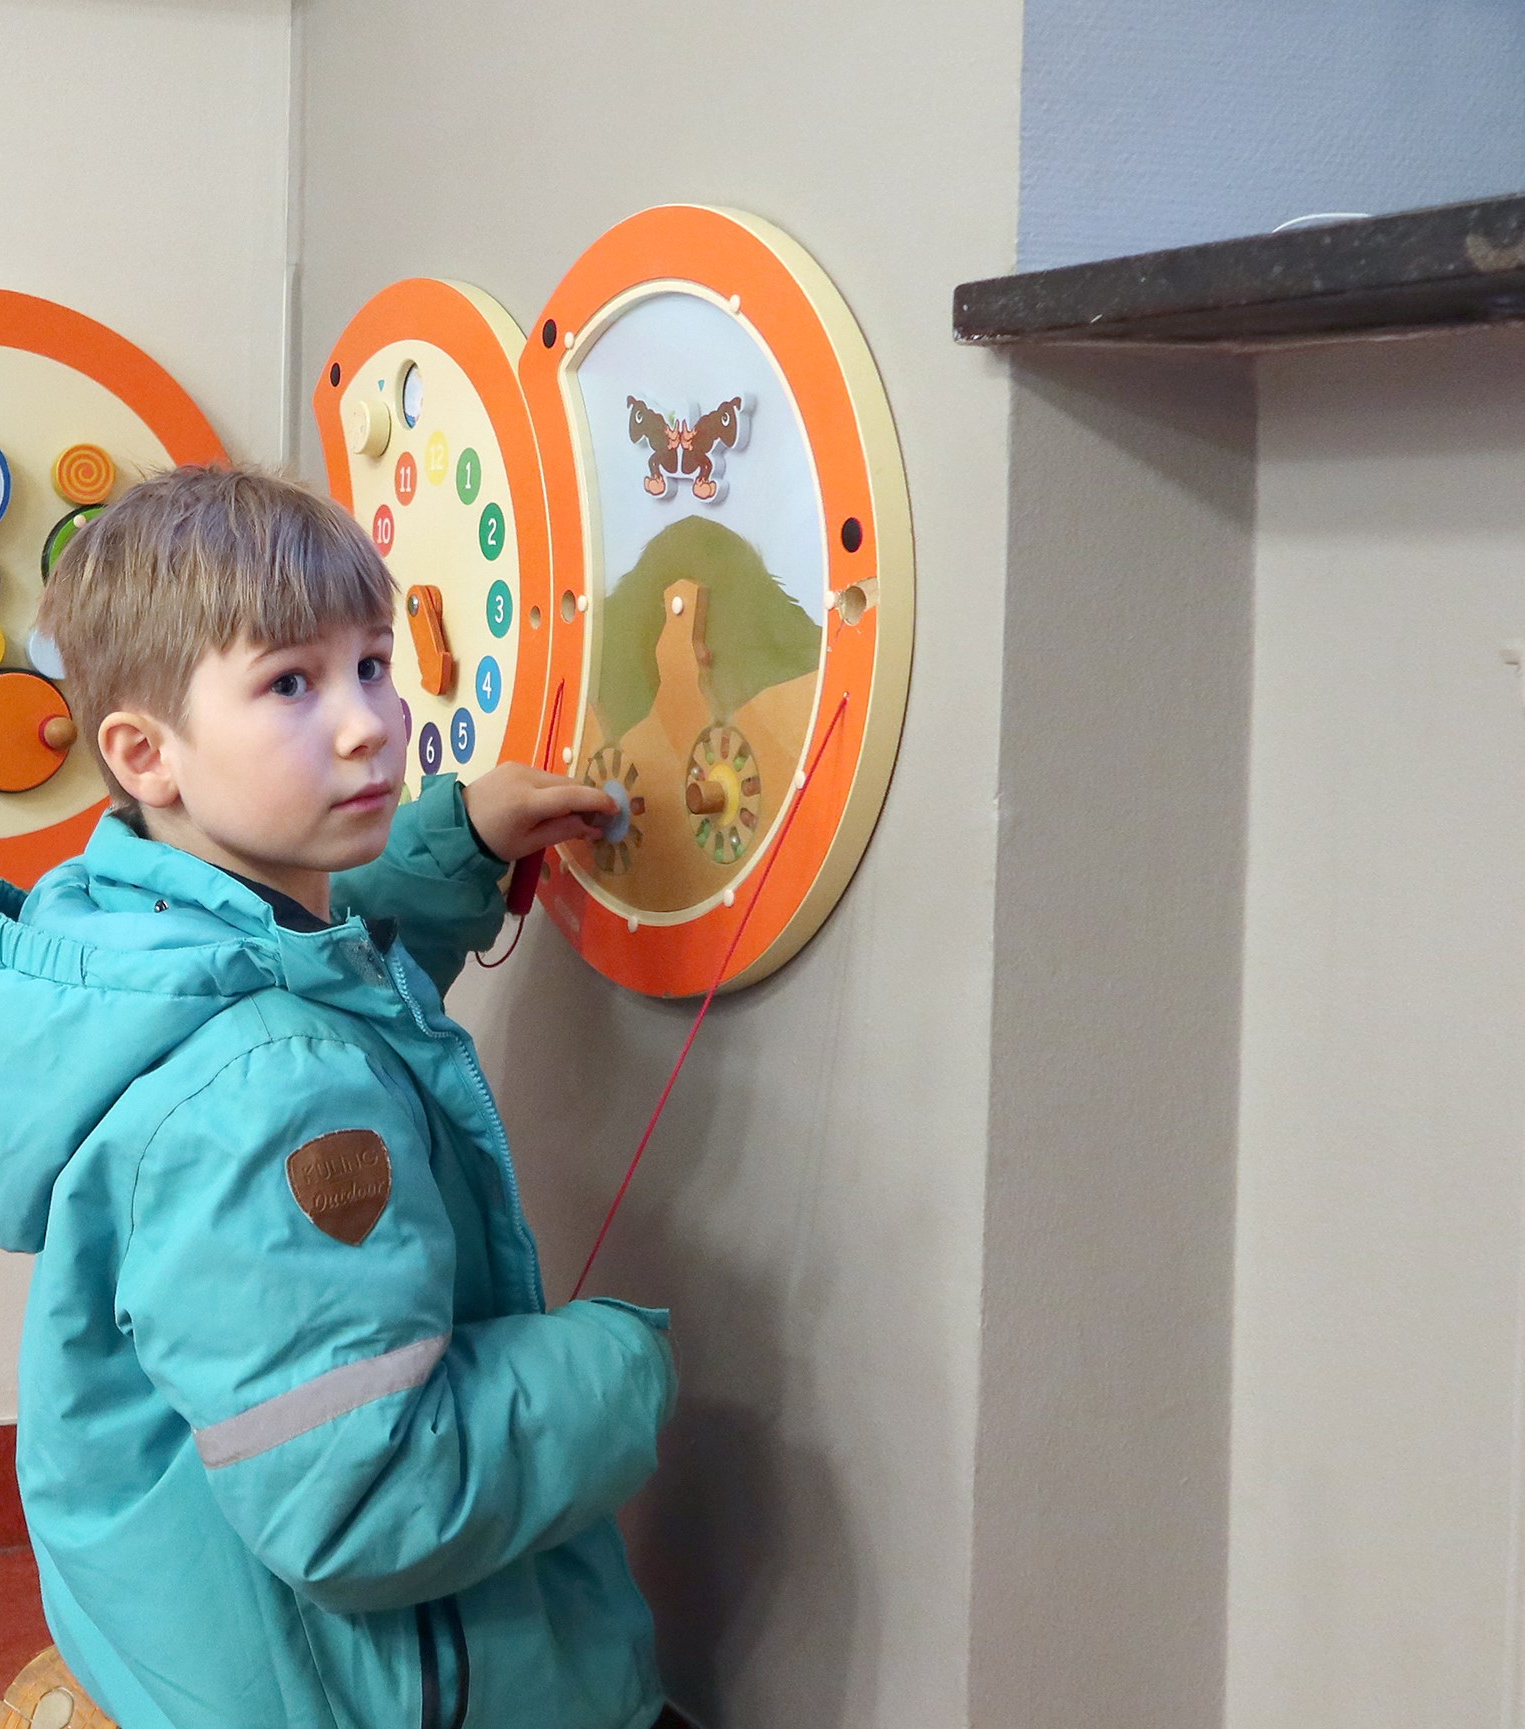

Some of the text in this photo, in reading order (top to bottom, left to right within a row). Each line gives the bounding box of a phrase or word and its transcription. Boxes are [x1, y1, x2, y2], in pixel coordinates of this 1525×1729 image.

[430, 444, 445, 469] 12
[399, 467, 412, 492] 11
[465, 463, 472, 489] 1
[377, 518, 391, 544] 10
[487, 518, 497, 546] 2
[495, 595, 504, 623] 3
[482, 671, 492, 700] 4
[426, 736, 435, 763] 6
[458, 722, 468, 750] 5
[313, 1180, 385, 1213] Outdoor
